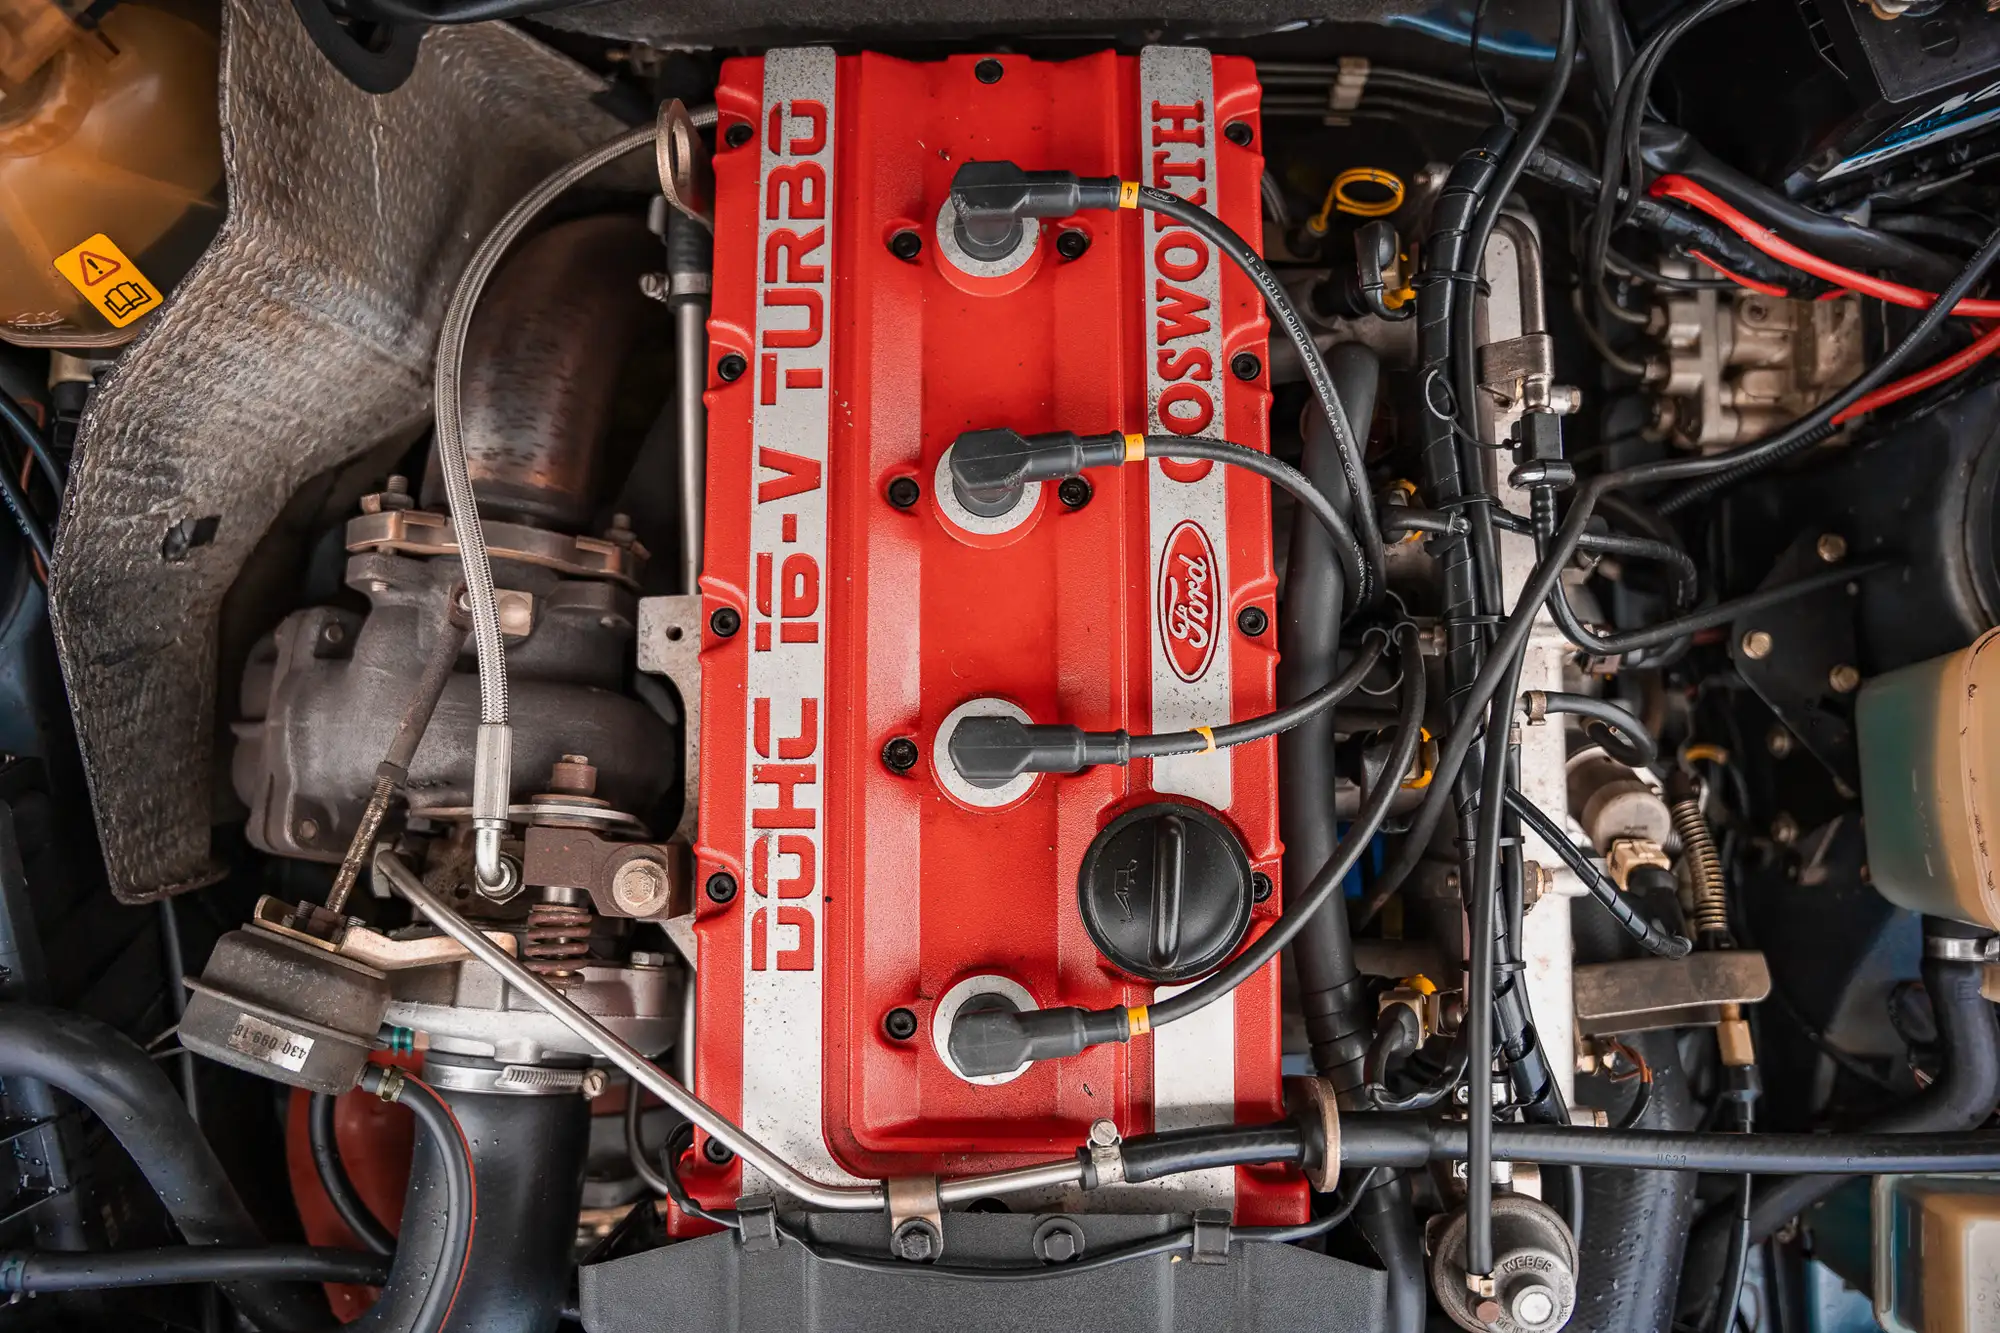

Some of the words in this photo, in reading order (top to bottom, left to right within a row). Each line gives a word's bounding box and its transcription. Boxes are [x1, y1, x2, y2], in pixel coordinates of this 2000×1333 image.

[761, 100, 827, 405] TURBO
[1259, 272, 1281, 301] K5214
[1283, 308, 1318, 376] BOUGICORD
[1317, 380, 1328, 399] 500
[1326, 404, 1343, 440] CLASS
[756, 447, 821, 651] 16-V
[1168, 554, 1209, 648] Ford
[752, 698, 817, 971] DOHC
[282, 1040, 307, 1059] 430
[1502, 1255, 1554, 1274] WEBER
